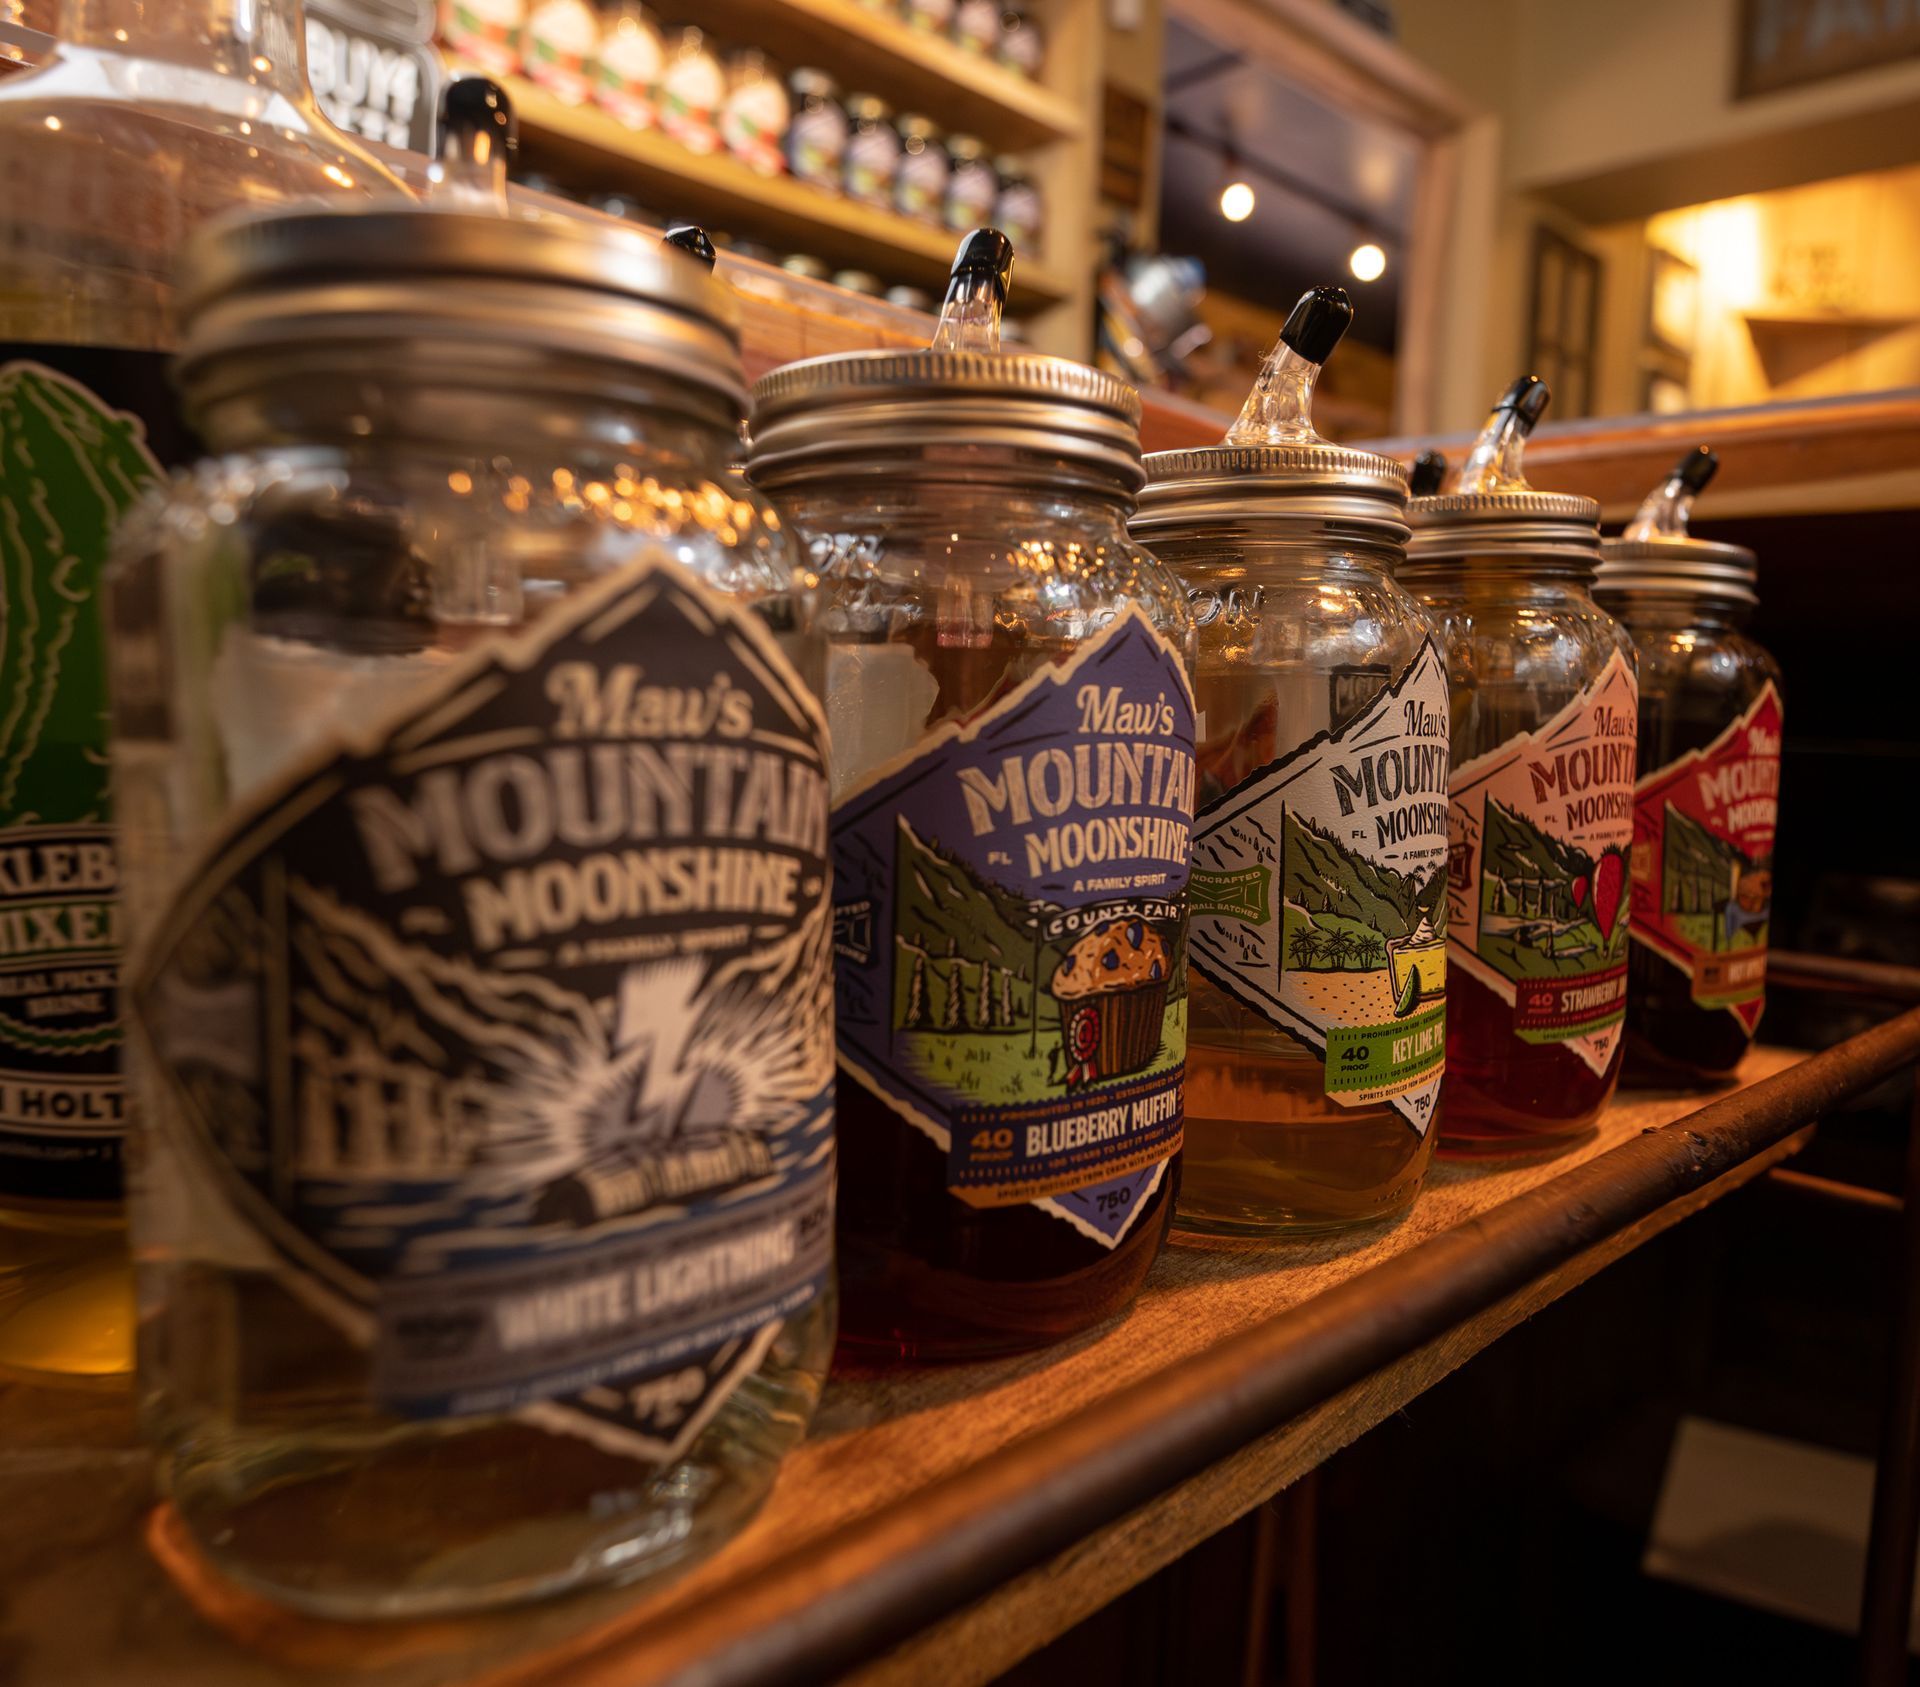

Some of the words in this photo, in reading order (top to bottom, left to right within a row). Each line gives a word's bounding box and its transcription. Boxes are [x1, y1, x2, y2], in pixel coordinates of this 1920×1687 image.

[545, 662, 753, 739] Maw's
[1077, 685, 1175, 736] Maw's
[1403, 700, 1447, 739] Maw's
[1594, 706, 1634, 737] Maw's
[956, 742, 1196, 837] MOUNTAI
[1352, 830, 1367, 840] FL
[988, 852, 1012, 865] FL
[1025, 816, 1188, 879] MOONSHINE
[1402, 852, 1408, 860] A
[1409, 849, 1429, 860] FAMILY
[1072, 880, 1084, 892] A
[1087, 877, 1131, 892] FAMILY
[1134, 873, 1167, 887] SPIRIT
[462, 845, 798, 949] MOONSHINE
[1049, 904, 1138, 935] COUNTY
[1145, 904, 1178, 919] FAIR
[1190, 903, 1215, 911] MALL
[1217, 903, 1259, 919] BATCHES
[1528, 993, 1553, 1006] 40
[1561, 981, 1618, 1013] STRAWBERRY
[1361, 1027, 1402, 1039] PROHIBITED
[1393, 1035, 1413, 1065] KEY
[1414, 1027, 1432, 1057] LIME
[1434, 1021, 1443, 1047] PIE
[1341, 1046, 1369, 1061] 40
[1341, 1063, 1369, 1072] PROOF
[1359, 1091, 1384, 1101] SPIRITS
[1414, 1093, 1430, 1113] 750
[1026, 1105, 1129, 1157] BLUEBERRY
[1132, 1088, 1176, 1132] MUFFIN
[970, 1128, 1014, 1150] 40
[1096, 1186, 1131, 1213] 750
